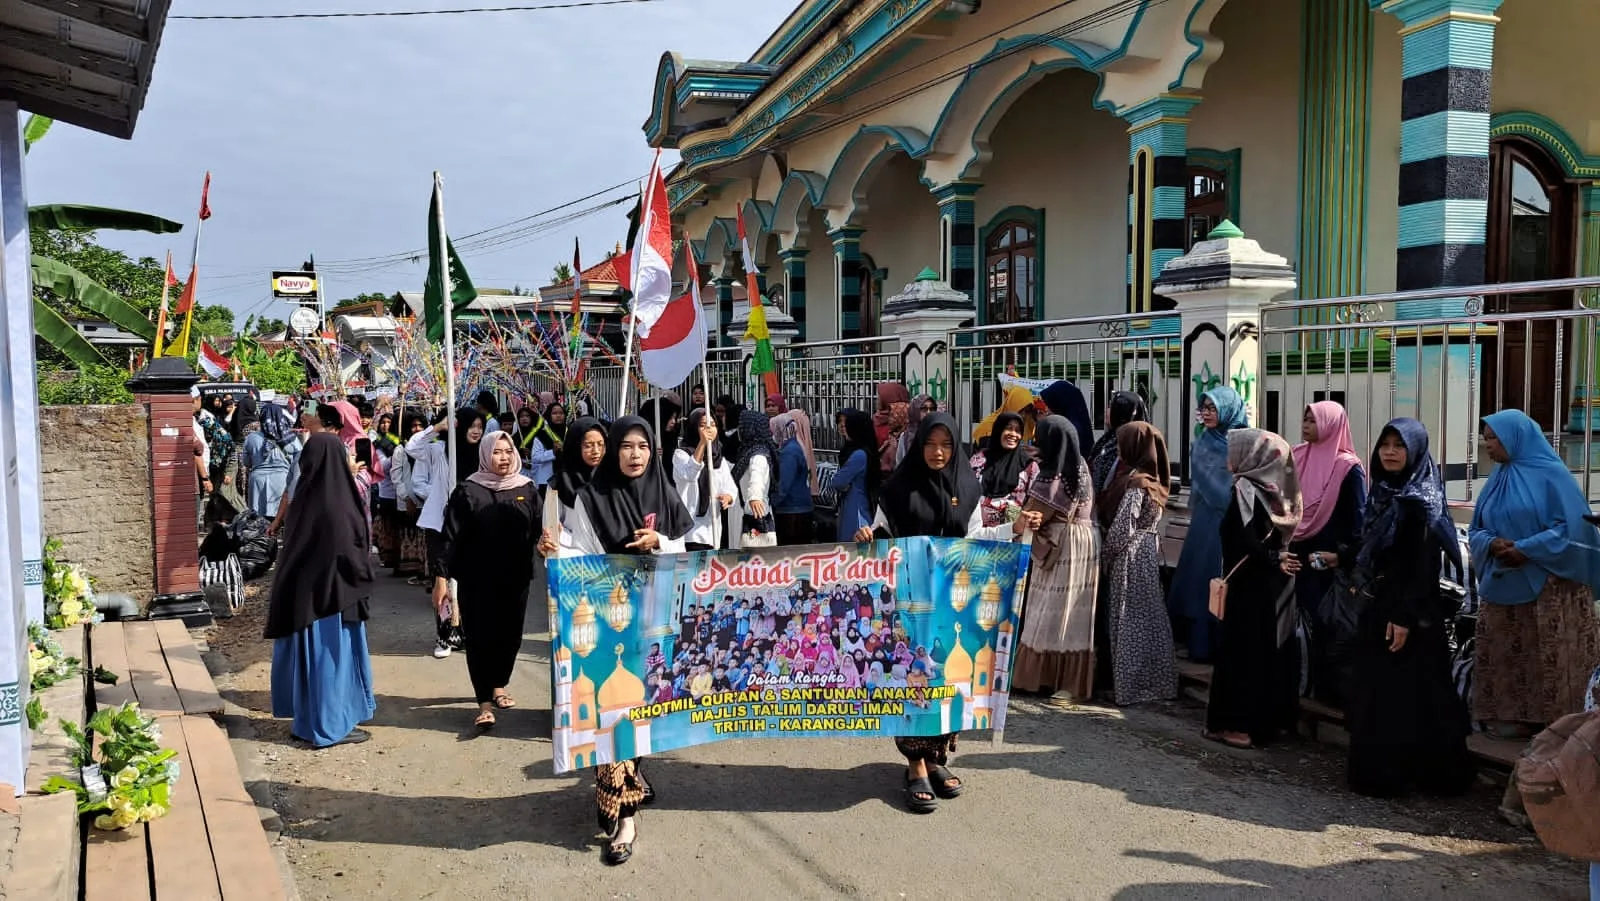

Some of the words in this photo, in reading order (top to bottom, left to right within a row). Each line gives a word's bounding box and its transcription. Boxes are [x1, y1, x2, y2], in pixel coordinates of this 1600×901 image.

[280, 279, 310, 289] Navya
[693, 556, 794, 593] Pawai
[747, 672, 790, 686] Dalam
[795, 671, 846, 687] Rangka
[629, 697, 697, 720] KHOTMIL
[701, 690, 760, 706] QUR'AN
[765, 689, 776, 701] &
[781, 687, 867, 701] SANTUNAN
[872, 686, 916, 700] ANAK
[921, 685, 956, 699] YATIM
[691, 705, 747, 724] MAJLIS
[752, 703, 802, 716] TA'LIM
[806, 703, 859, 716] DARUL
[863, 702, 904, 715] IMAN
[714, 718, 765, 734] TRITIH
[779, 717, 880, 731] KARANGJATI
